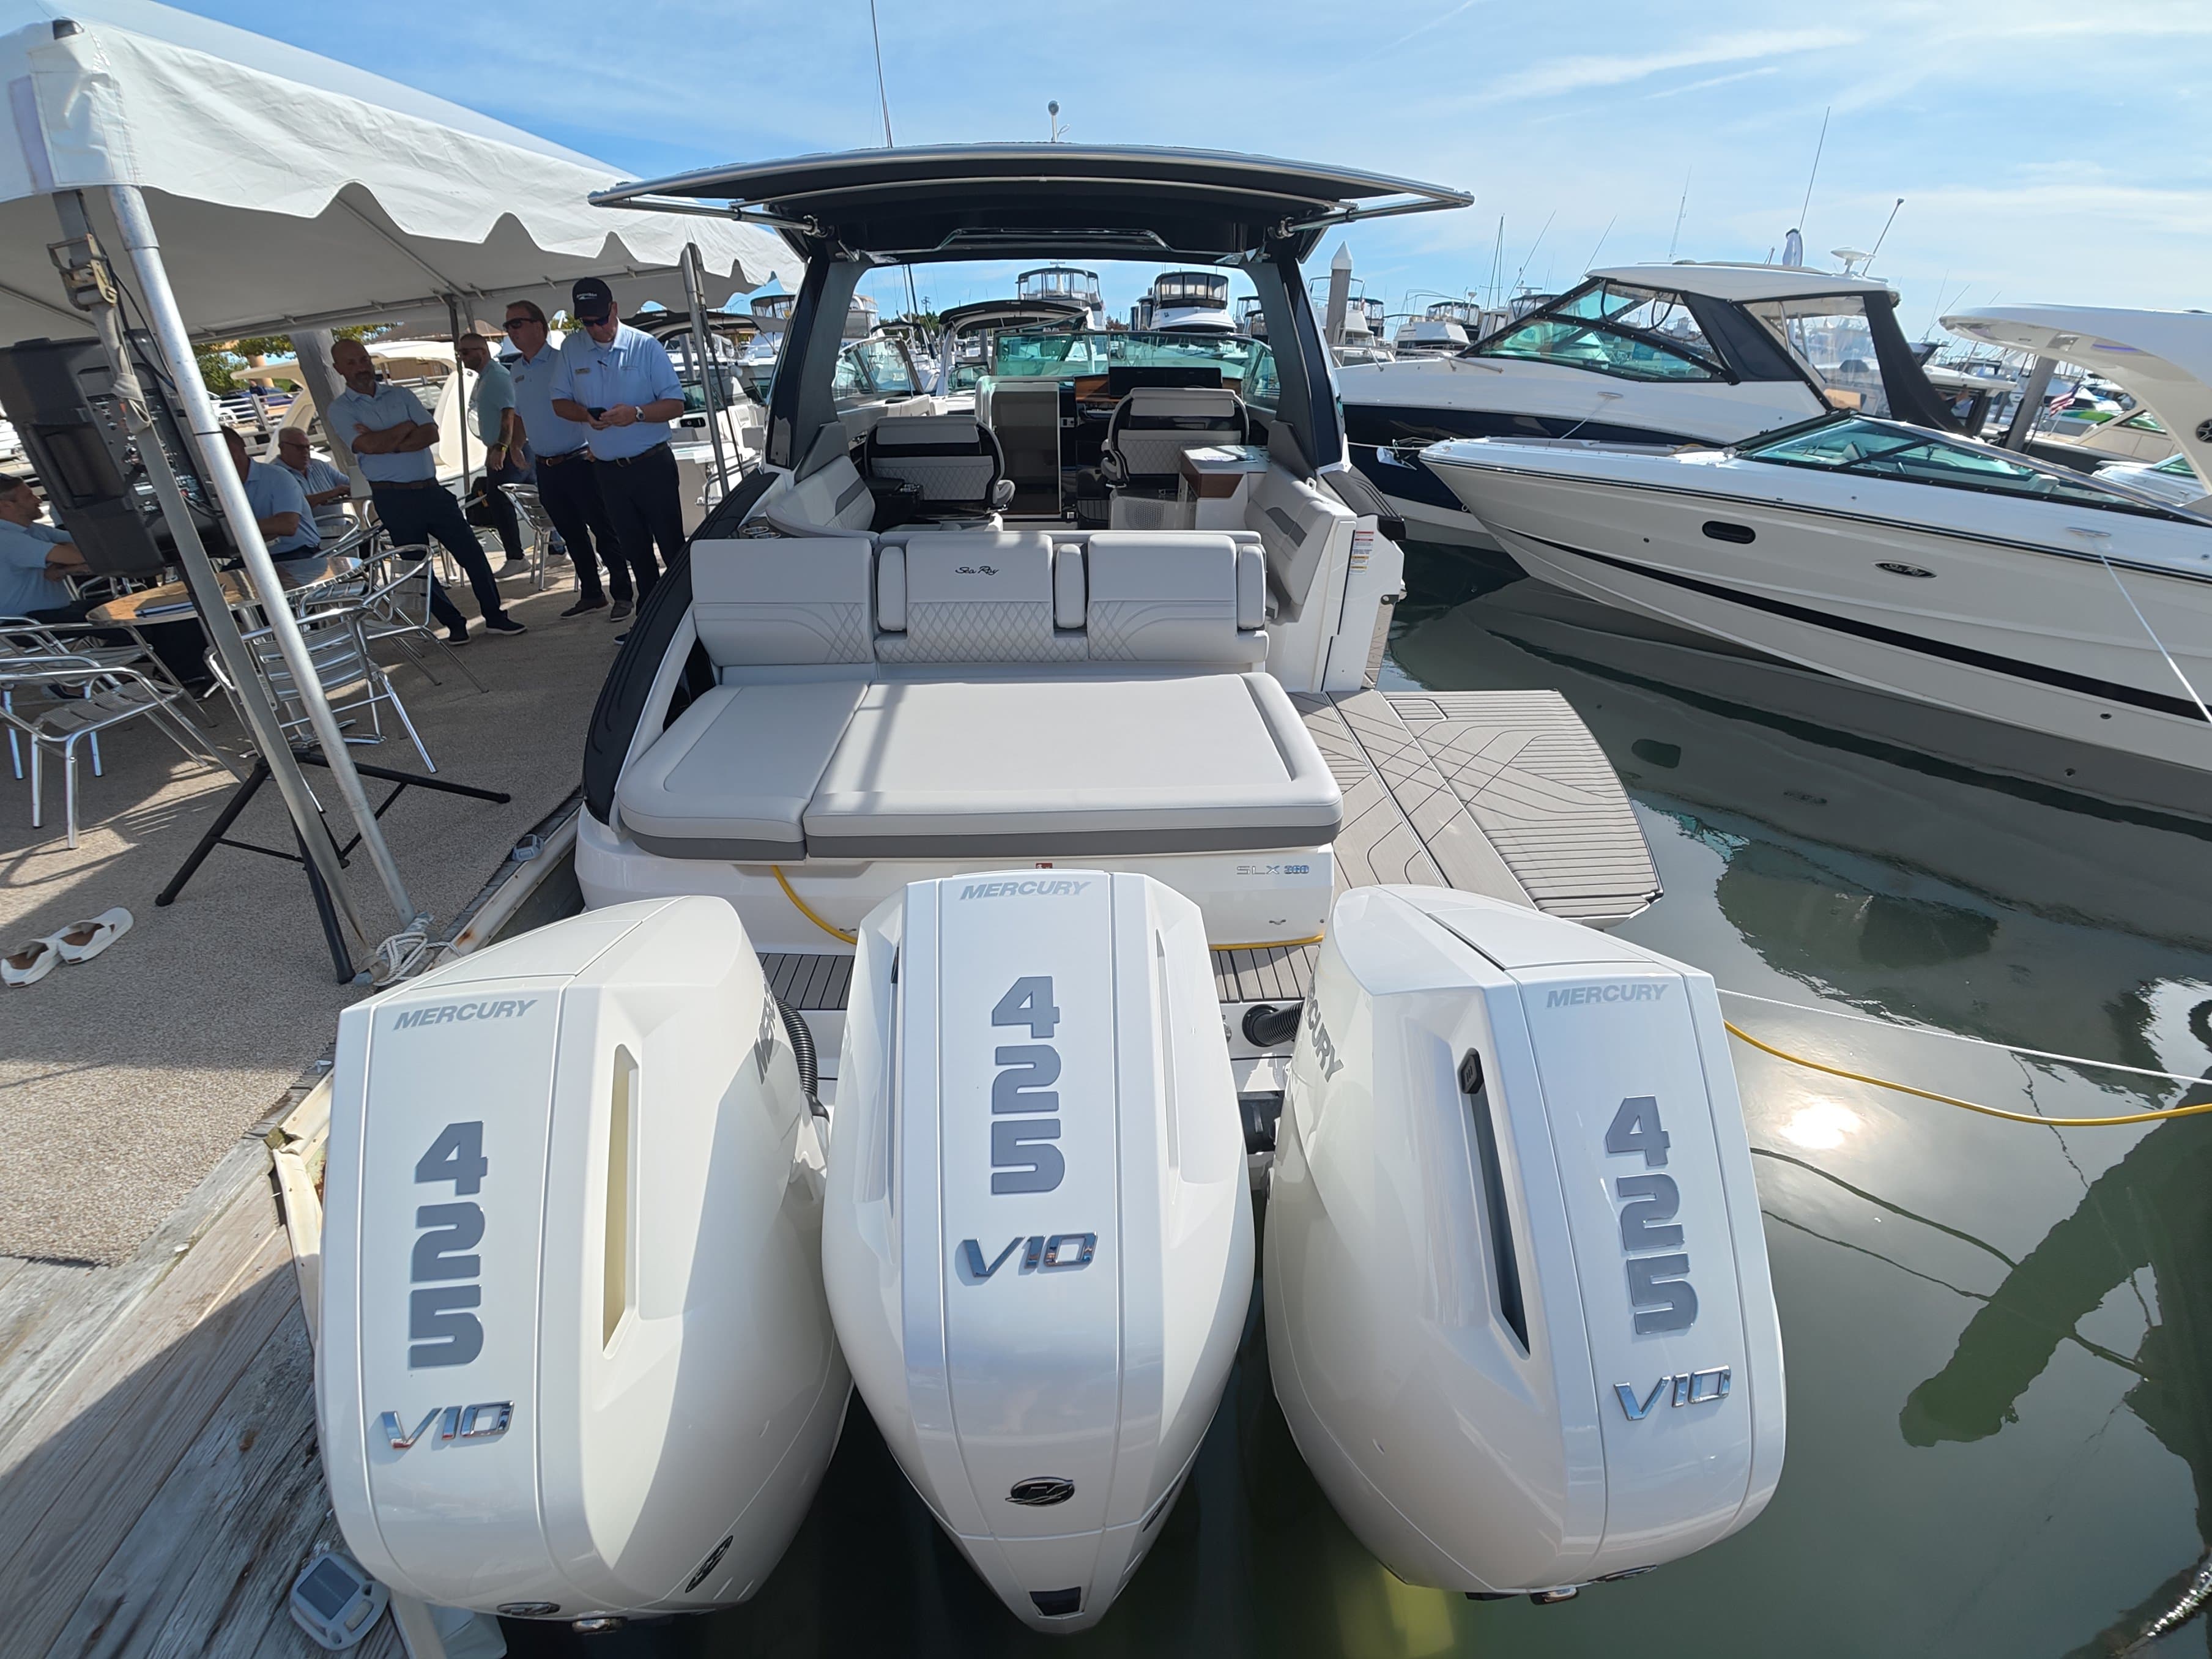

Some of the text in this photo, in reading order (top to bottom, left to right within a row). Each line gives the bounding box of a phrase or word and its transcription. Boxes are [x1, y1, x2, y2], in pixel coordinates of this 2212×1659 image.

[978, 565, 1000, 576] Ray
[959, 880, 1091, 900] MERCURY
[1236, 866, 1280, 875] SLX
[393, 1000, 538, 1030] MERCURY
[1546, 984, 1669, 1008] MERCURY
[992, 976, 1066, 1195] 425
[1605, 1094, 1699, 1335] 425
[409, 1120, 488, 1370] 425
[962, 1231, 1098, 1278] V10
[1614, 1365, 1732, 1421] V10
[381, 1400, 514, 1449] V10
